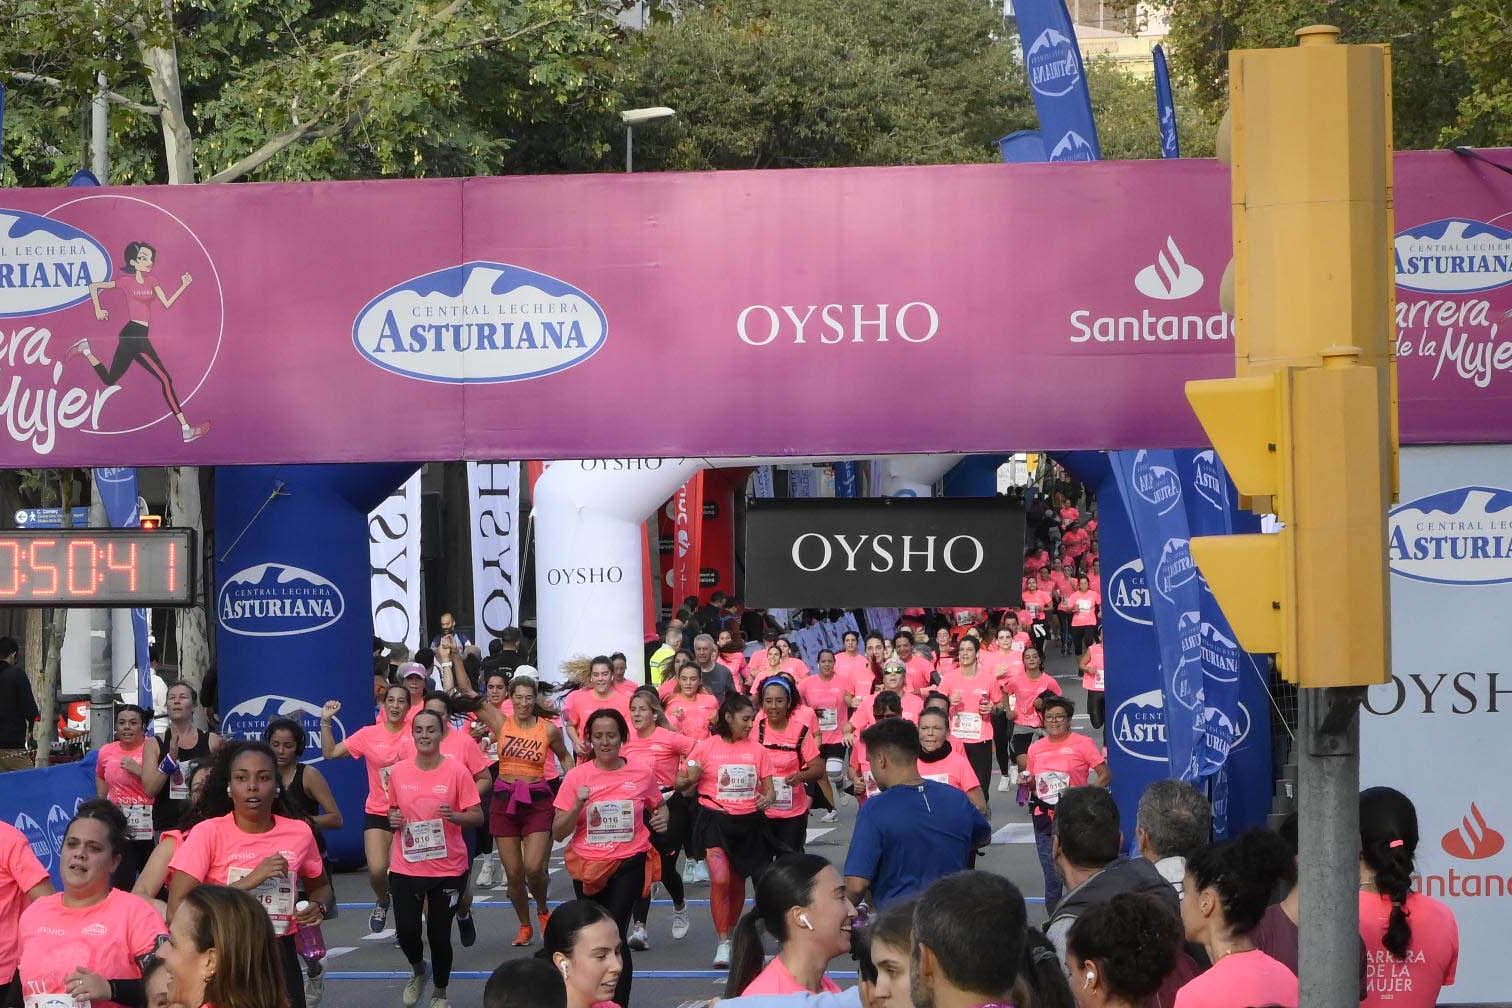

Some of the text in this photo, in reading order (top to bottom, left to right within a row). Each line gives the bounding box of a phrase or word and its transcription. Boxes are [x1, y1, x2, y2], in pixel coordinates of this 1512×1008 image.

[15, 244, 87, 256] LECHERA
[1410, 244, 1459, 253] CENTRAL
[412, 302, 579, 318] CENTRAL LECHERA
[373, 310, 587, 354] ASTURIANA
[737, 302, 939, 346] OYSHO
[1070, 311, 1237, 343] Santand
[1419, 330, 1436, 357] la
[1417, 521, 1483, 532] CENTRAL
[791, 533, 984, 574] OYSHO
[547, 566, 623, 586] OYSHO
[235, 587, 330, 596] CENTRAL LECHERA
[222, 593, 335, 620] ASTURIANA
[512, 737, 542, 751] RUN
[506, 747, 542, 762] NERS
[1366, 964, 1410, 978] DE LA
